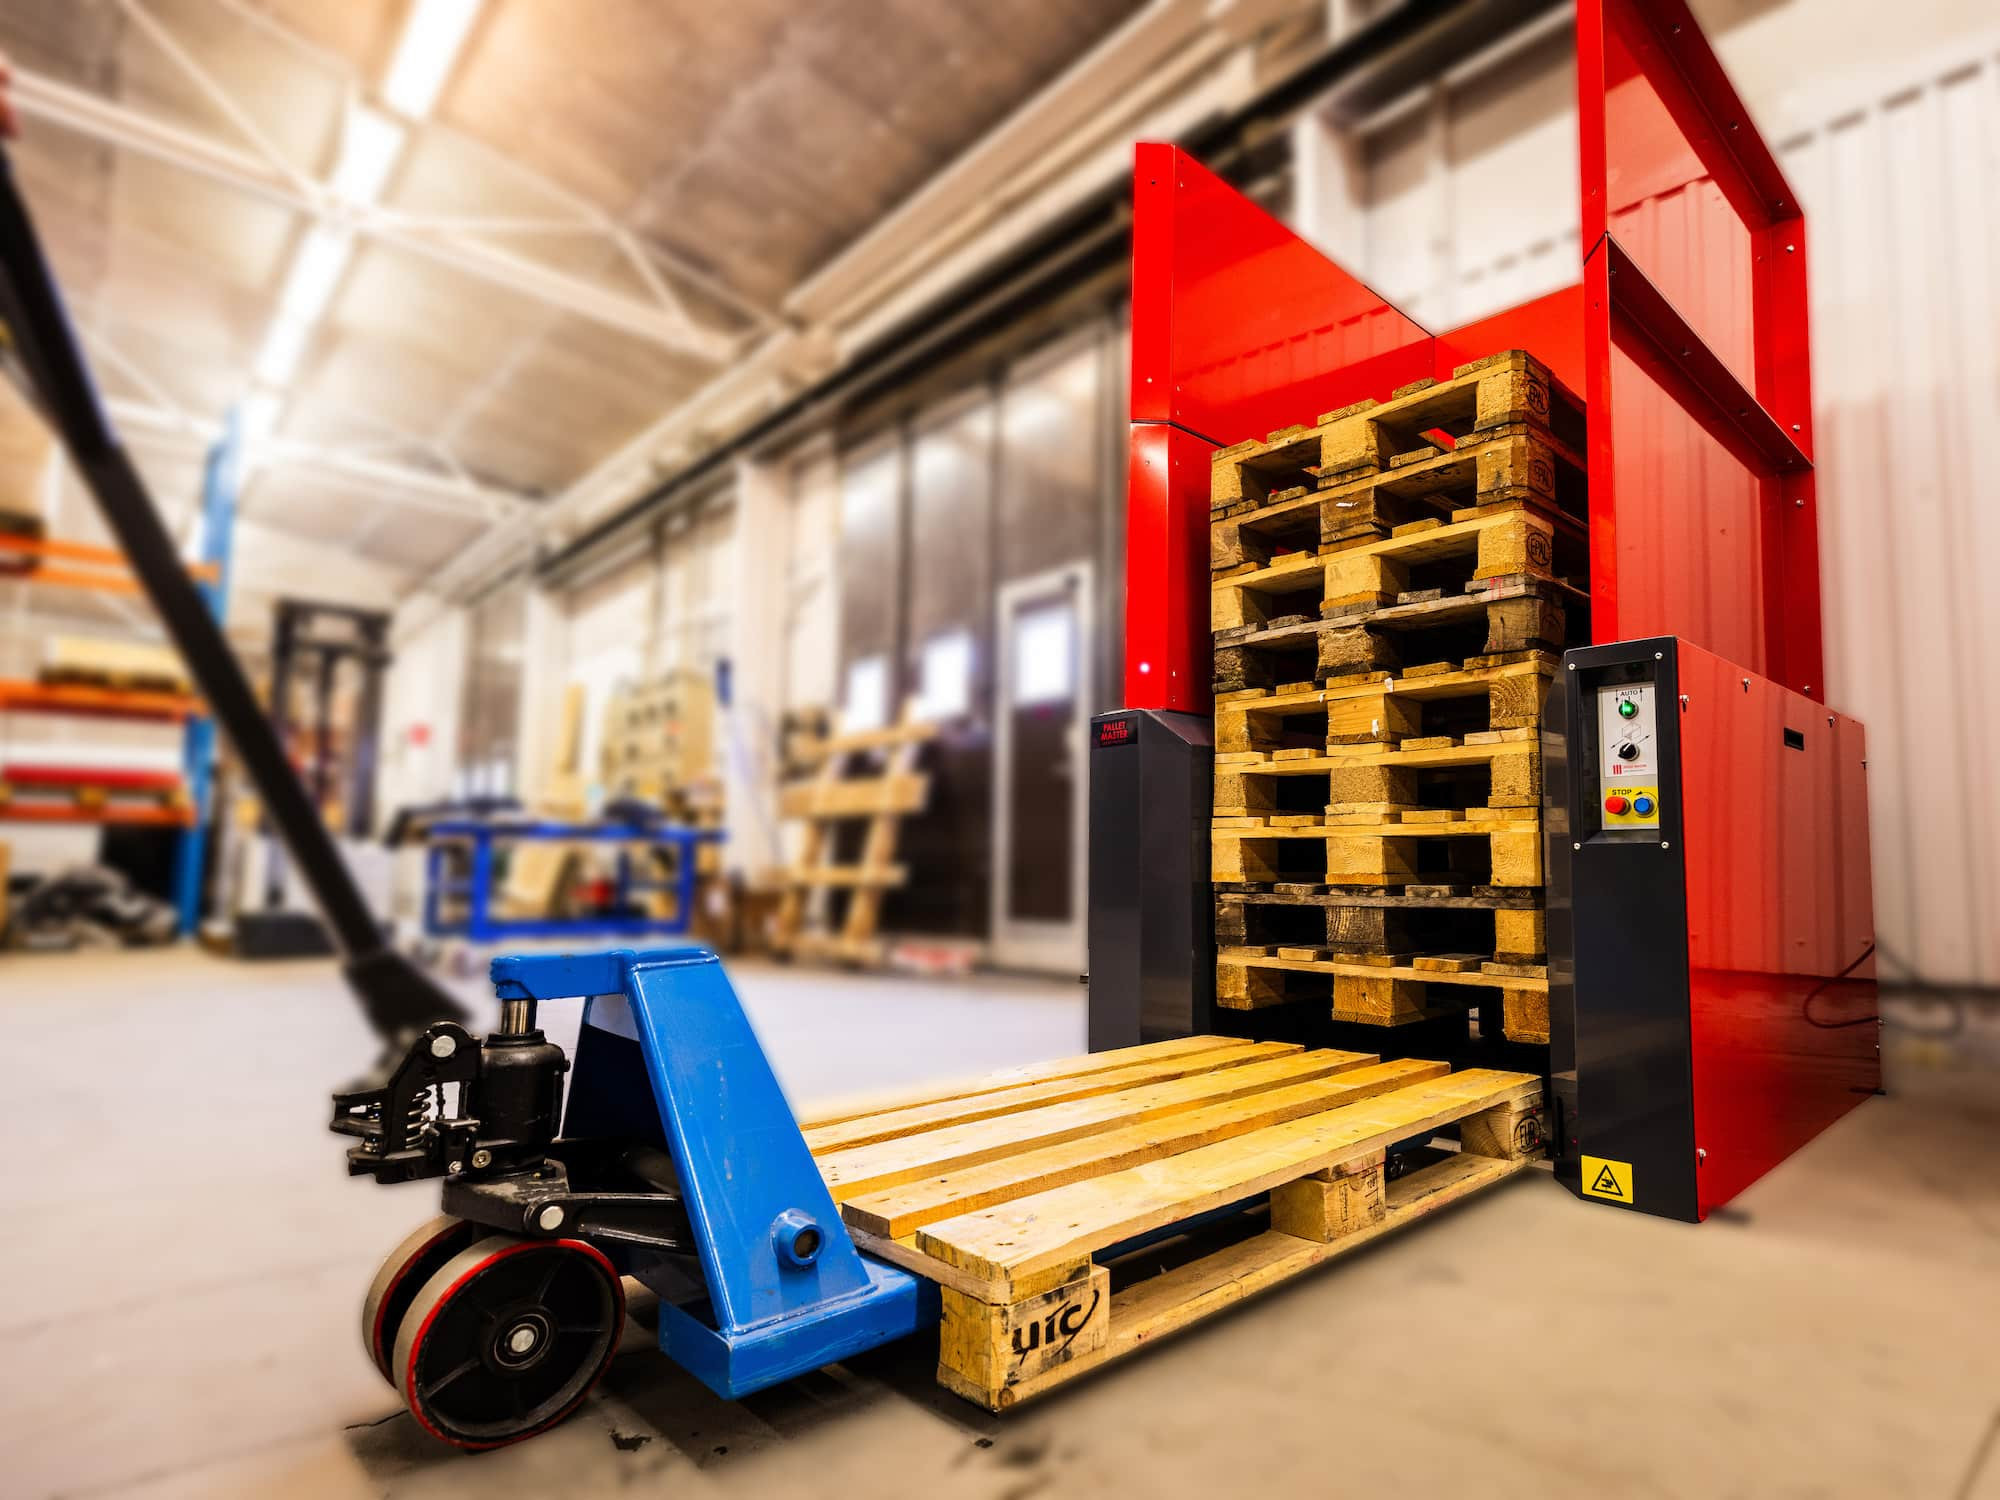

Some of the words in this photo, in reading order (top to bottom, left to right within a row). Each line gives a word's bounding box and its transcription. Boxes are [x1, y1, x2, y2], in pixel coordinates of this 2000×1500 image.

[1530, 538, 1547, 561] EPAL
[1103, 721, 1126, 732] PALLET
[1100, 729, 1129, 741] MASTER
